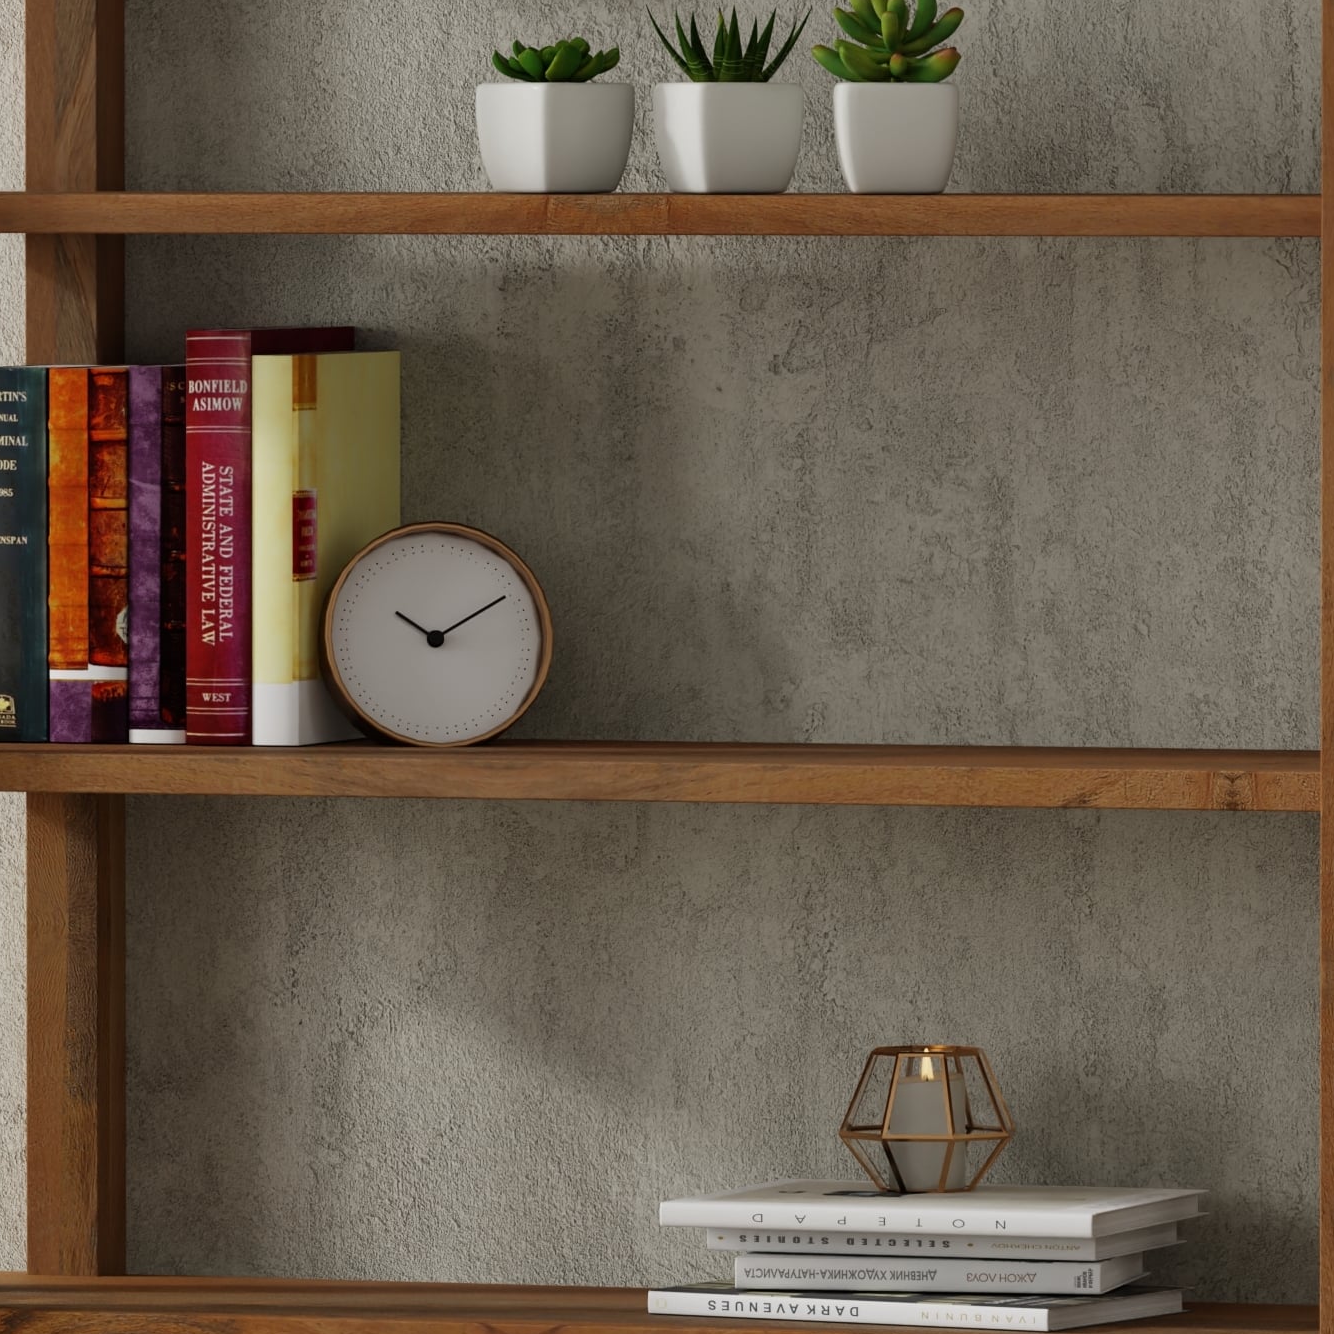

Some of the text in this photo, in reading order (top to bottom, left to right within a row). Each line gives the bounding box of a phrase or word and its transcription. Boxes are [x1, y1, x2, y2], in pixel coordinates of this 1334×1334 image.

[188, 379, 248, 394] BONFIELD
[192, 397, 243, 411] ASIMOW
[201, 461, 216, 646] ADMINISTRATIVE LAW
[219, 466, 234, 642] STATE AND FEDERAL
[202, 693, 232, 703] WEST
[752, 1213, 1006, 1230] NOTEPAD
[739, 1235, 829, 1245] STORIES
[846, 1237, 950, 1247] SELECTED
[745, 1268, 1037, 1283] ДЖОН ЛОУЗ ДНЕВНИК ХУДОЖНИКА-НАТУРАЛИСТА
[708, 1300, 1036, 1325] IVAN BUNIN DARK AVENUES
